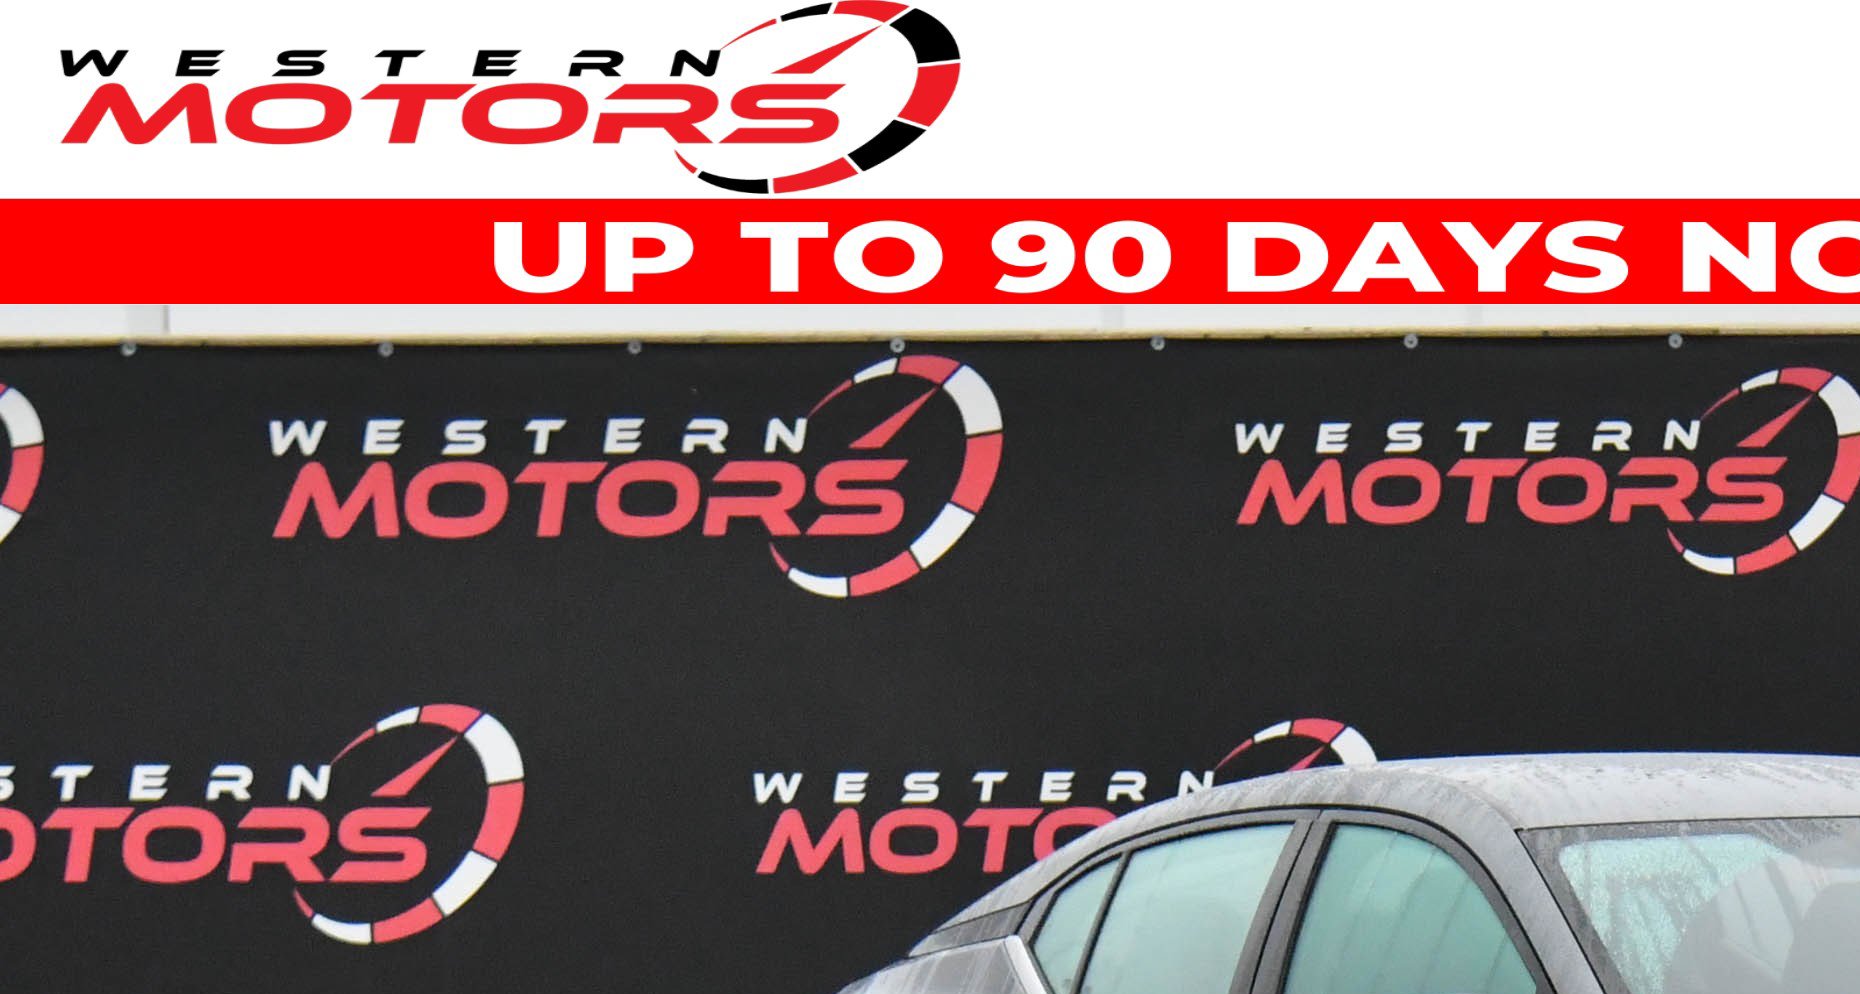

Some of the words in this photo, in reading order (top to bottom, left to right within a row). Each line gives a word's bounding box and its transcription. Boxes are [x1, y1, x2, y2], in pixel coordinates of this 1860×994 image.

[270, 418, 808, 456] WESTERN
[1235, 420, 1701, 454] WESTERN
[273, 460, 908, 539] MOTORS
[1237, 456, 1787, 526] MOTORS
[753, 771, 1213, 803] WESTERN
